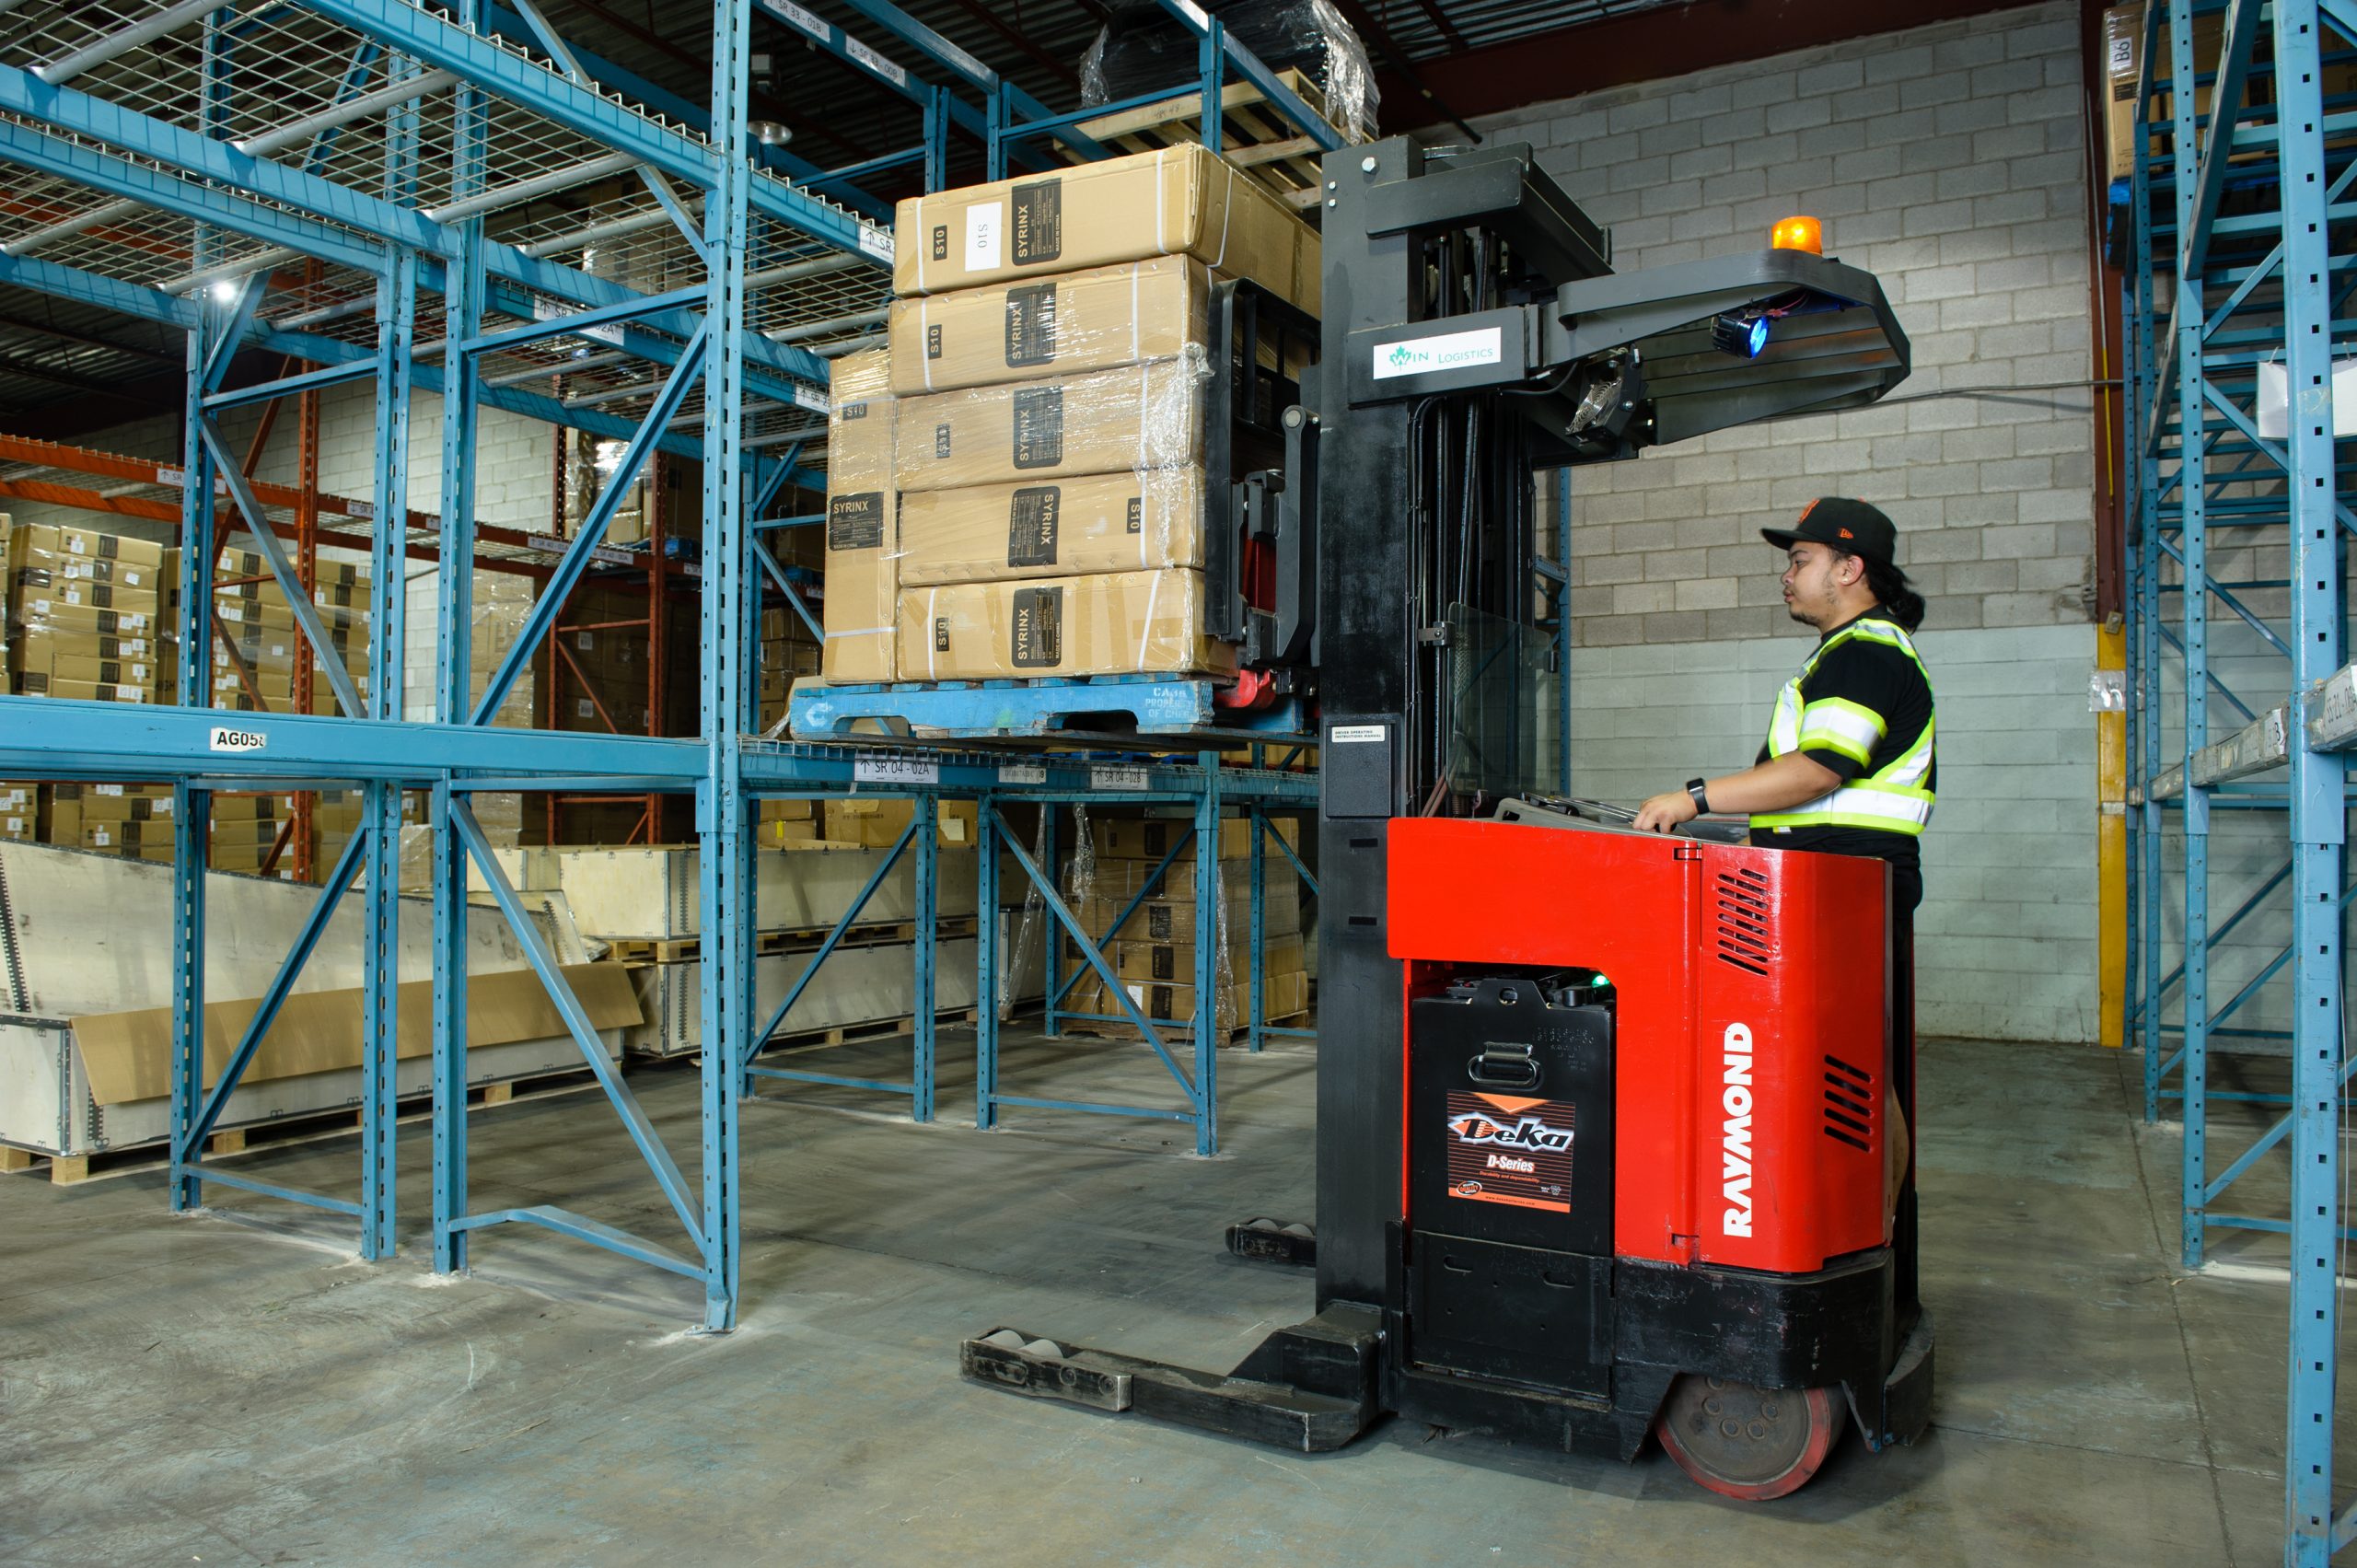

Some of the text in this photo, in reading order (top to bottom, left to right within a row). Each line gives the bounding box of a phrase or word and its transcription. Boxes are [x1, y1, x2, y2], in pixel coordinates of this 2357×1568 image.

[778, 1, 788, 12] SR
[791, 6, 801, 20] 33
[807, 17, 821, 33] 01B
[2114, 41, 2131, 63] B6
[935, 229, 945, 255] S10
[977, 223, 988, 249] S10
[1017, 204, 1028, 258] SYRINX
[879, 238, 892, 254] SR
[555, 308, 568, 318] SR
[930, 329, 939, 354] S10
[1012, 307, 1023, 360] SYRINX
[1438, 348, 1493, 364] LOGISTICS
[811, 392, 819, 405] SR
[846, 404, 865, 417] S10
[1019, 409, 1030, 461] SYRINX
[833, 500, 869, 515] SYRINX
[1040, 494, 1054, 545] SYRINX
[1130, 504, 1141, 529] S10
[937, 621, 946, 646] S10
[1017, 608, 1029, 660] SYRINX
[875, 761, 888, 773] SR
[892, 761, 904, 774] 04
[911, 762, 930, 775] 02A
[1105, 772, 1113, 783] SR
[1116, 772, 1124, 782] 04
[1459, 1117, 1571, 1149] Deka
[1723, 1022, 1753, 1238] RAYMOND
[1487, 1155, 1534, 1172] D-Series
